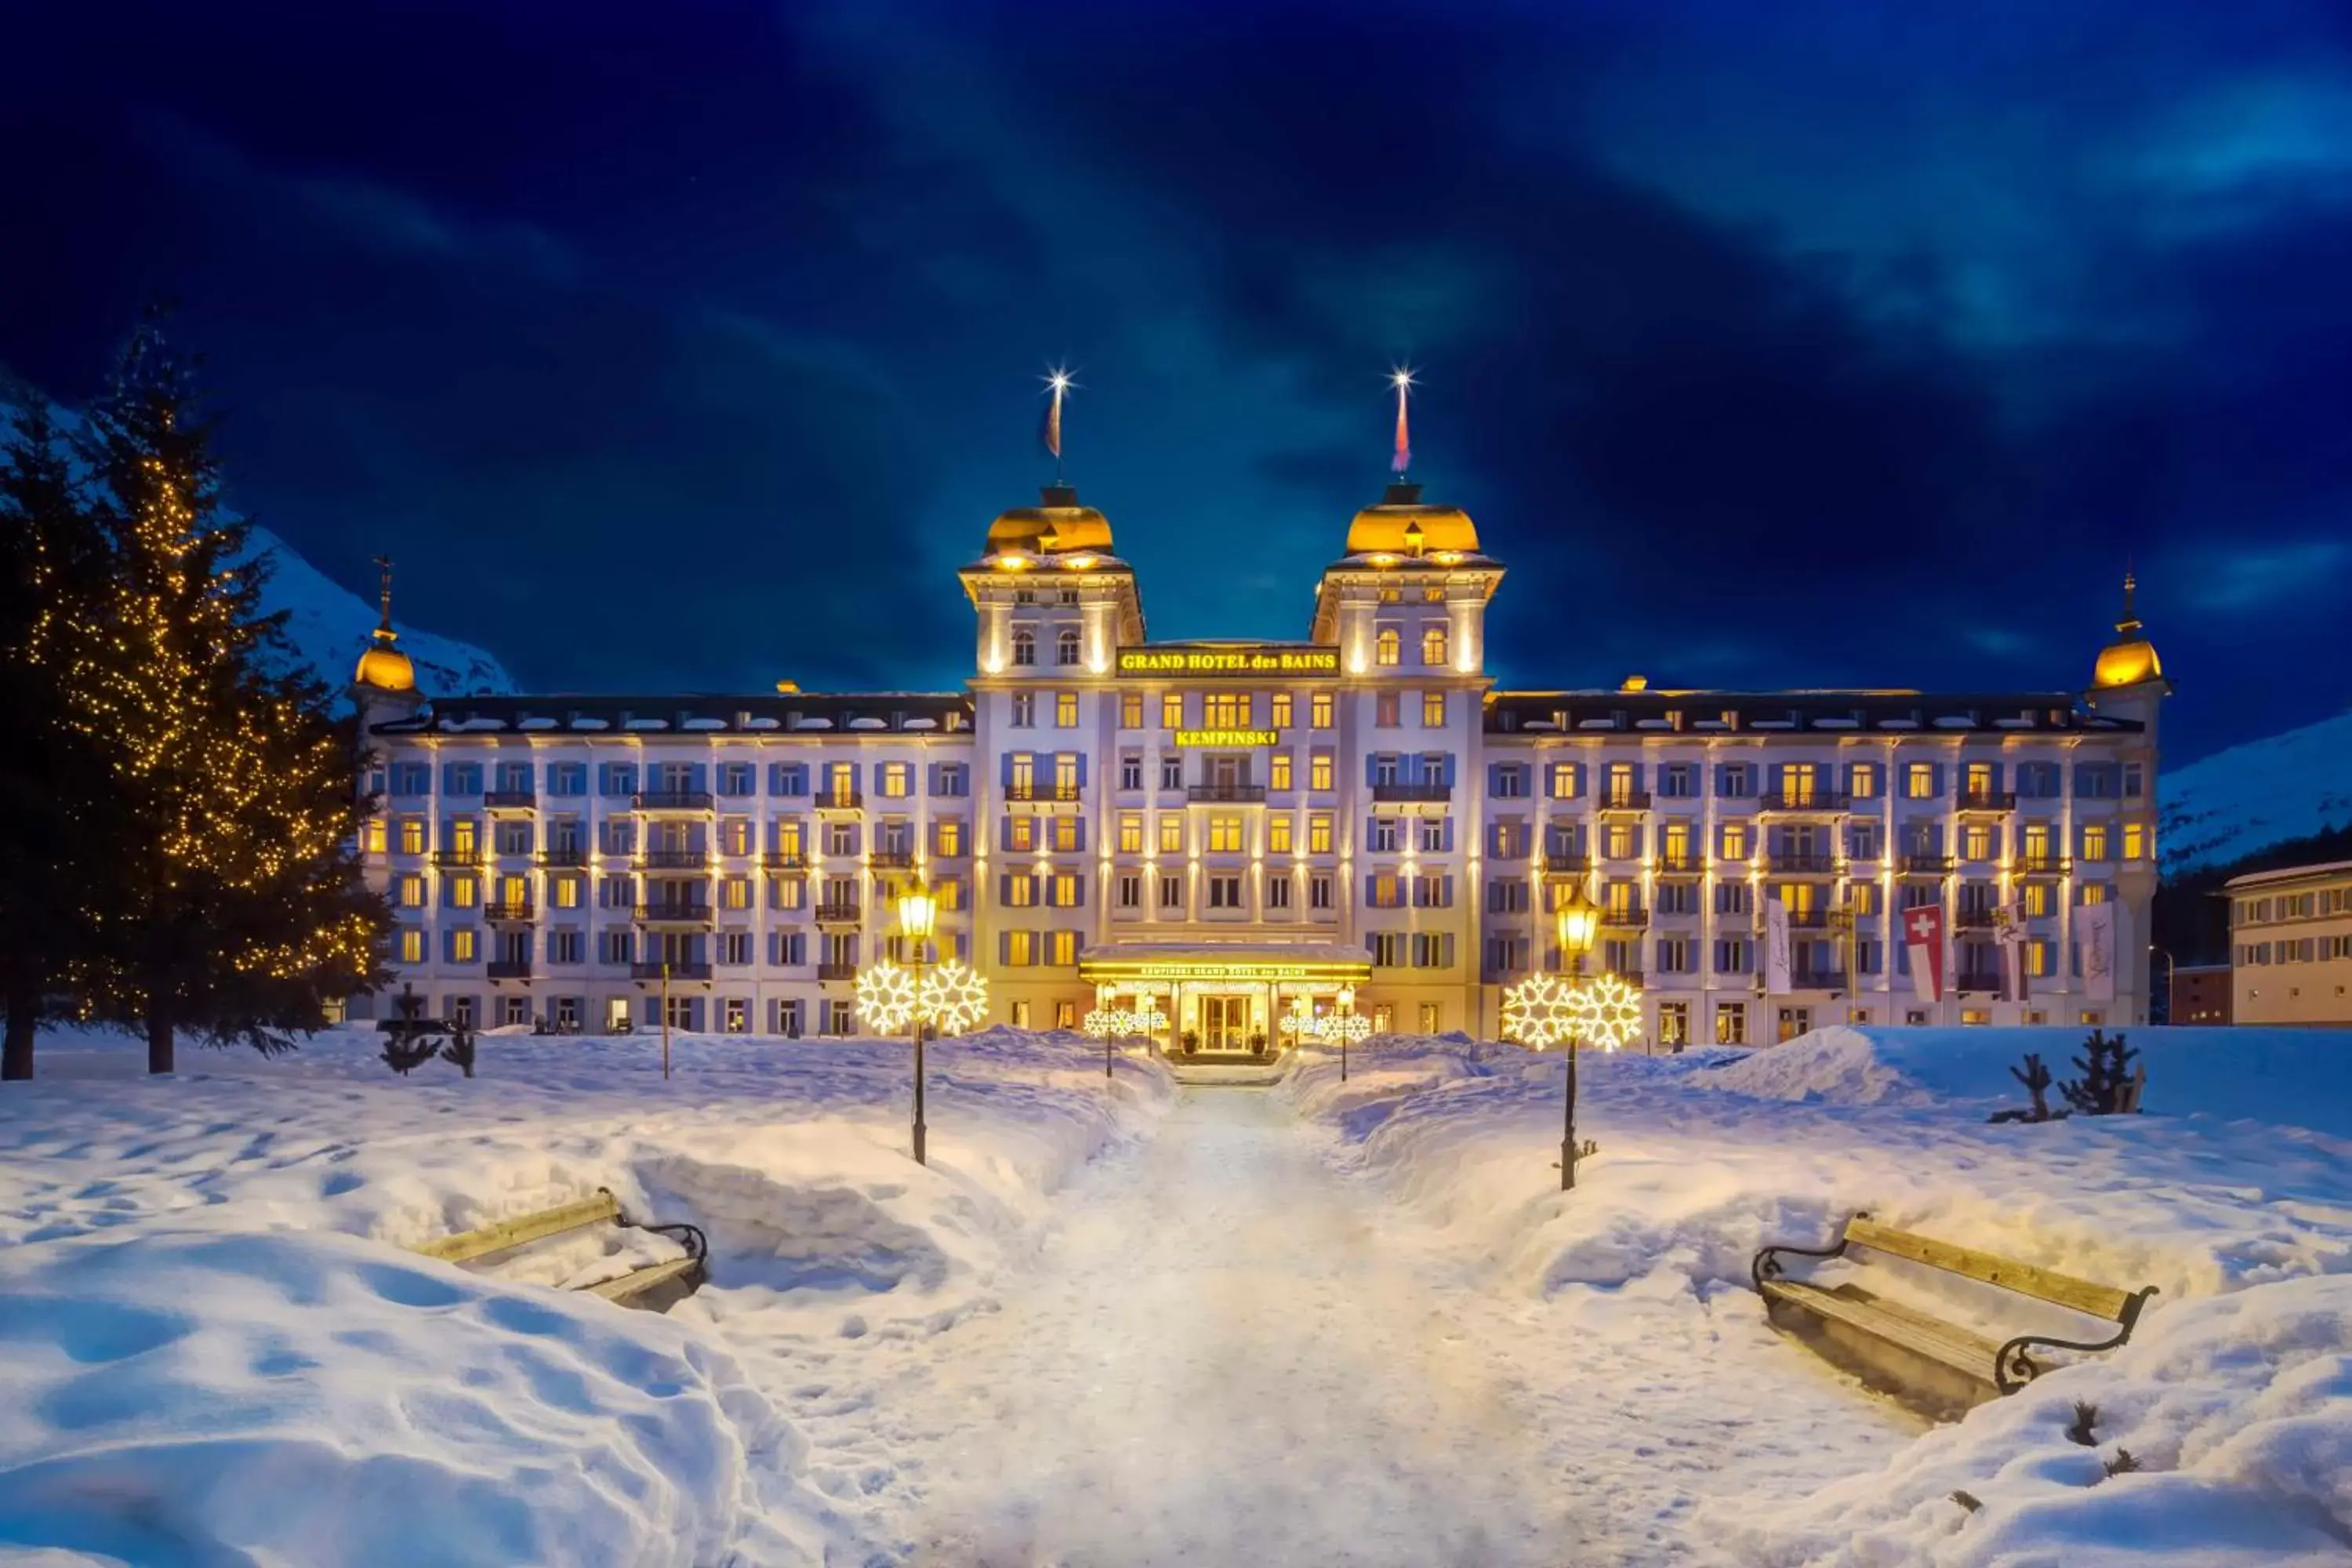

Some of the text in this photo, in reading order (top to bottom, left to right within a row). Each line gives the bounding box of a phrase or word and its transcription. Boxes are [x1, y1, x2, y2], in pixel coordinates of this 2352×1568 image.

[1121, 655, 1336, 669] GRAND HOTEL des BAINS
[1176, 731, 1276, 745] KEMPINSKI
